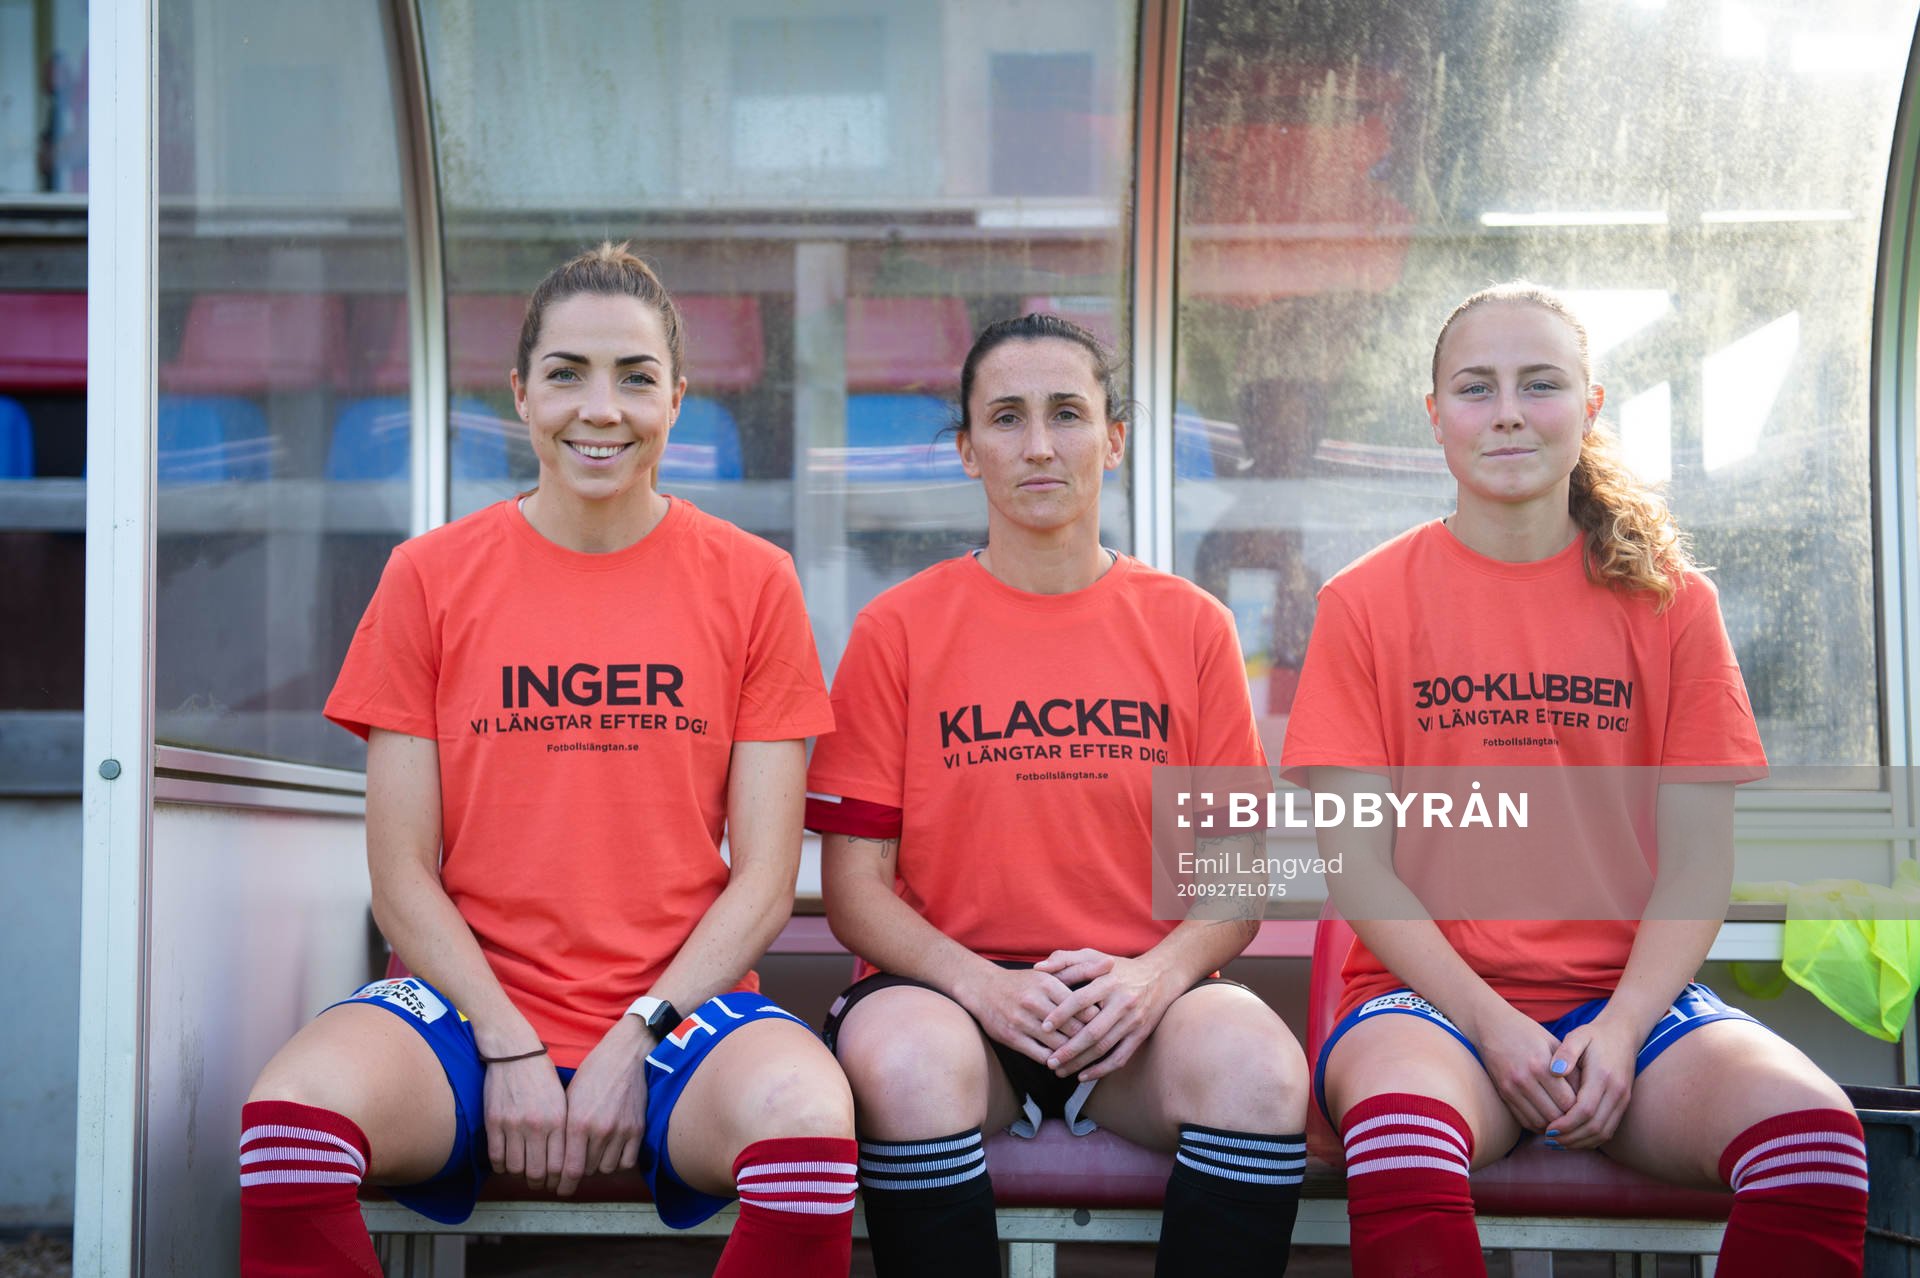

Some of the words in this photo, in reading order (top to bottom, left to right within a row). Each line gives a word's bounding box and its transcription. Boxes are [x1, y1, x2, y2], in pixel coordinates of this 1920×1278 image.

[502, 663, 684, 708] INGER
[1413, 672, 1633, 709] 300-KLUBBEN
[471, 719, 488, 735] VI
[496, 713, 592, 733] LÄNGTAR
[600, 714, 667, 730] EFTER
[939, 698, 1169, 749] KLACKEN
[1417, 716, 1434, 732] VI
[1439, 708, 1528, 729] LÄNGTAR
[546, 742, 639, 753] Fotbollslängtan.se
[944, 753, 960, 769] VI
[967, 745, 1061, 765] LÄNGTAR
[1070, 744, 1133, 759] EFTER
[1140, 746, 1168, 764] DIG!
[1016, 771, 1109, 781] Fotbollslängtan.se
